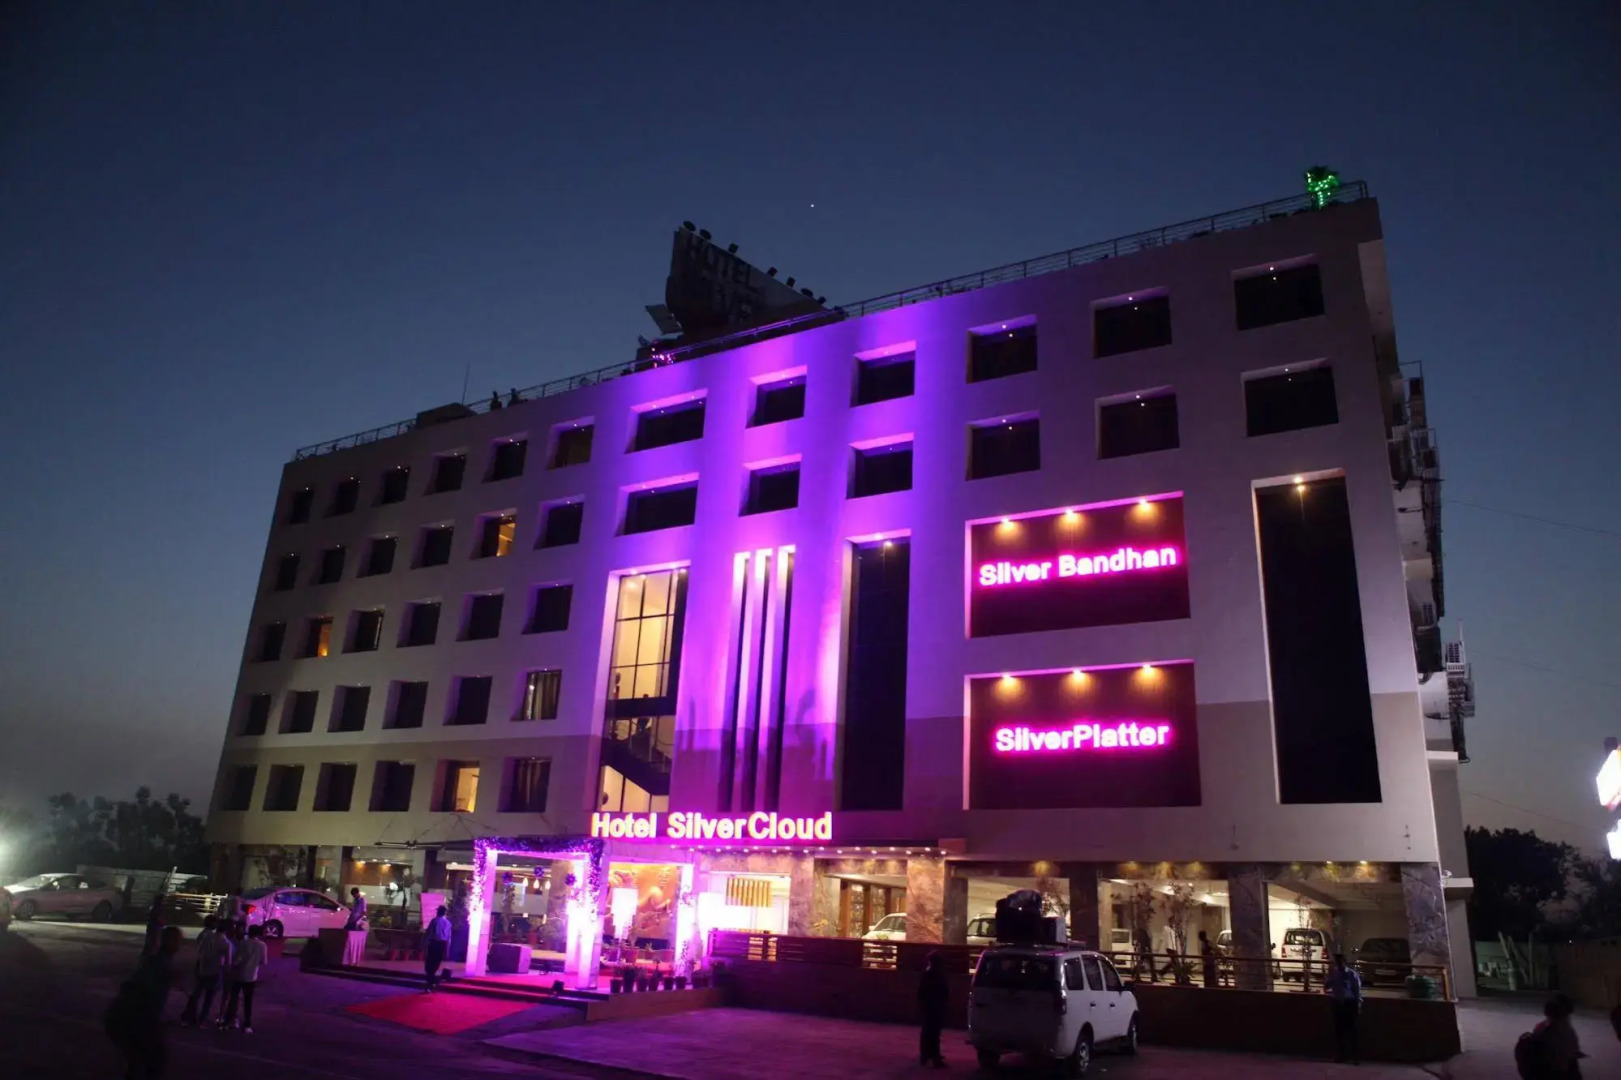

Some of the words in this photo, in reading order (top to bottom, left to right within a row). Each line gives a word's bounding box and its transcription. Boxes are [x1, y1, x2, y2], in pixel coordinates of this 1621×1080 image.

[687, 232, 758, 294] HOTEL
[979, 561, 1052, 587] Silver
[1058, 547, 1177, 578] Bandhan
[995, 722, 1170, 753] SilverPlatter
[590, 811, 659, 840] Hotel
[666, 811, 834, 841] SilverCloud
